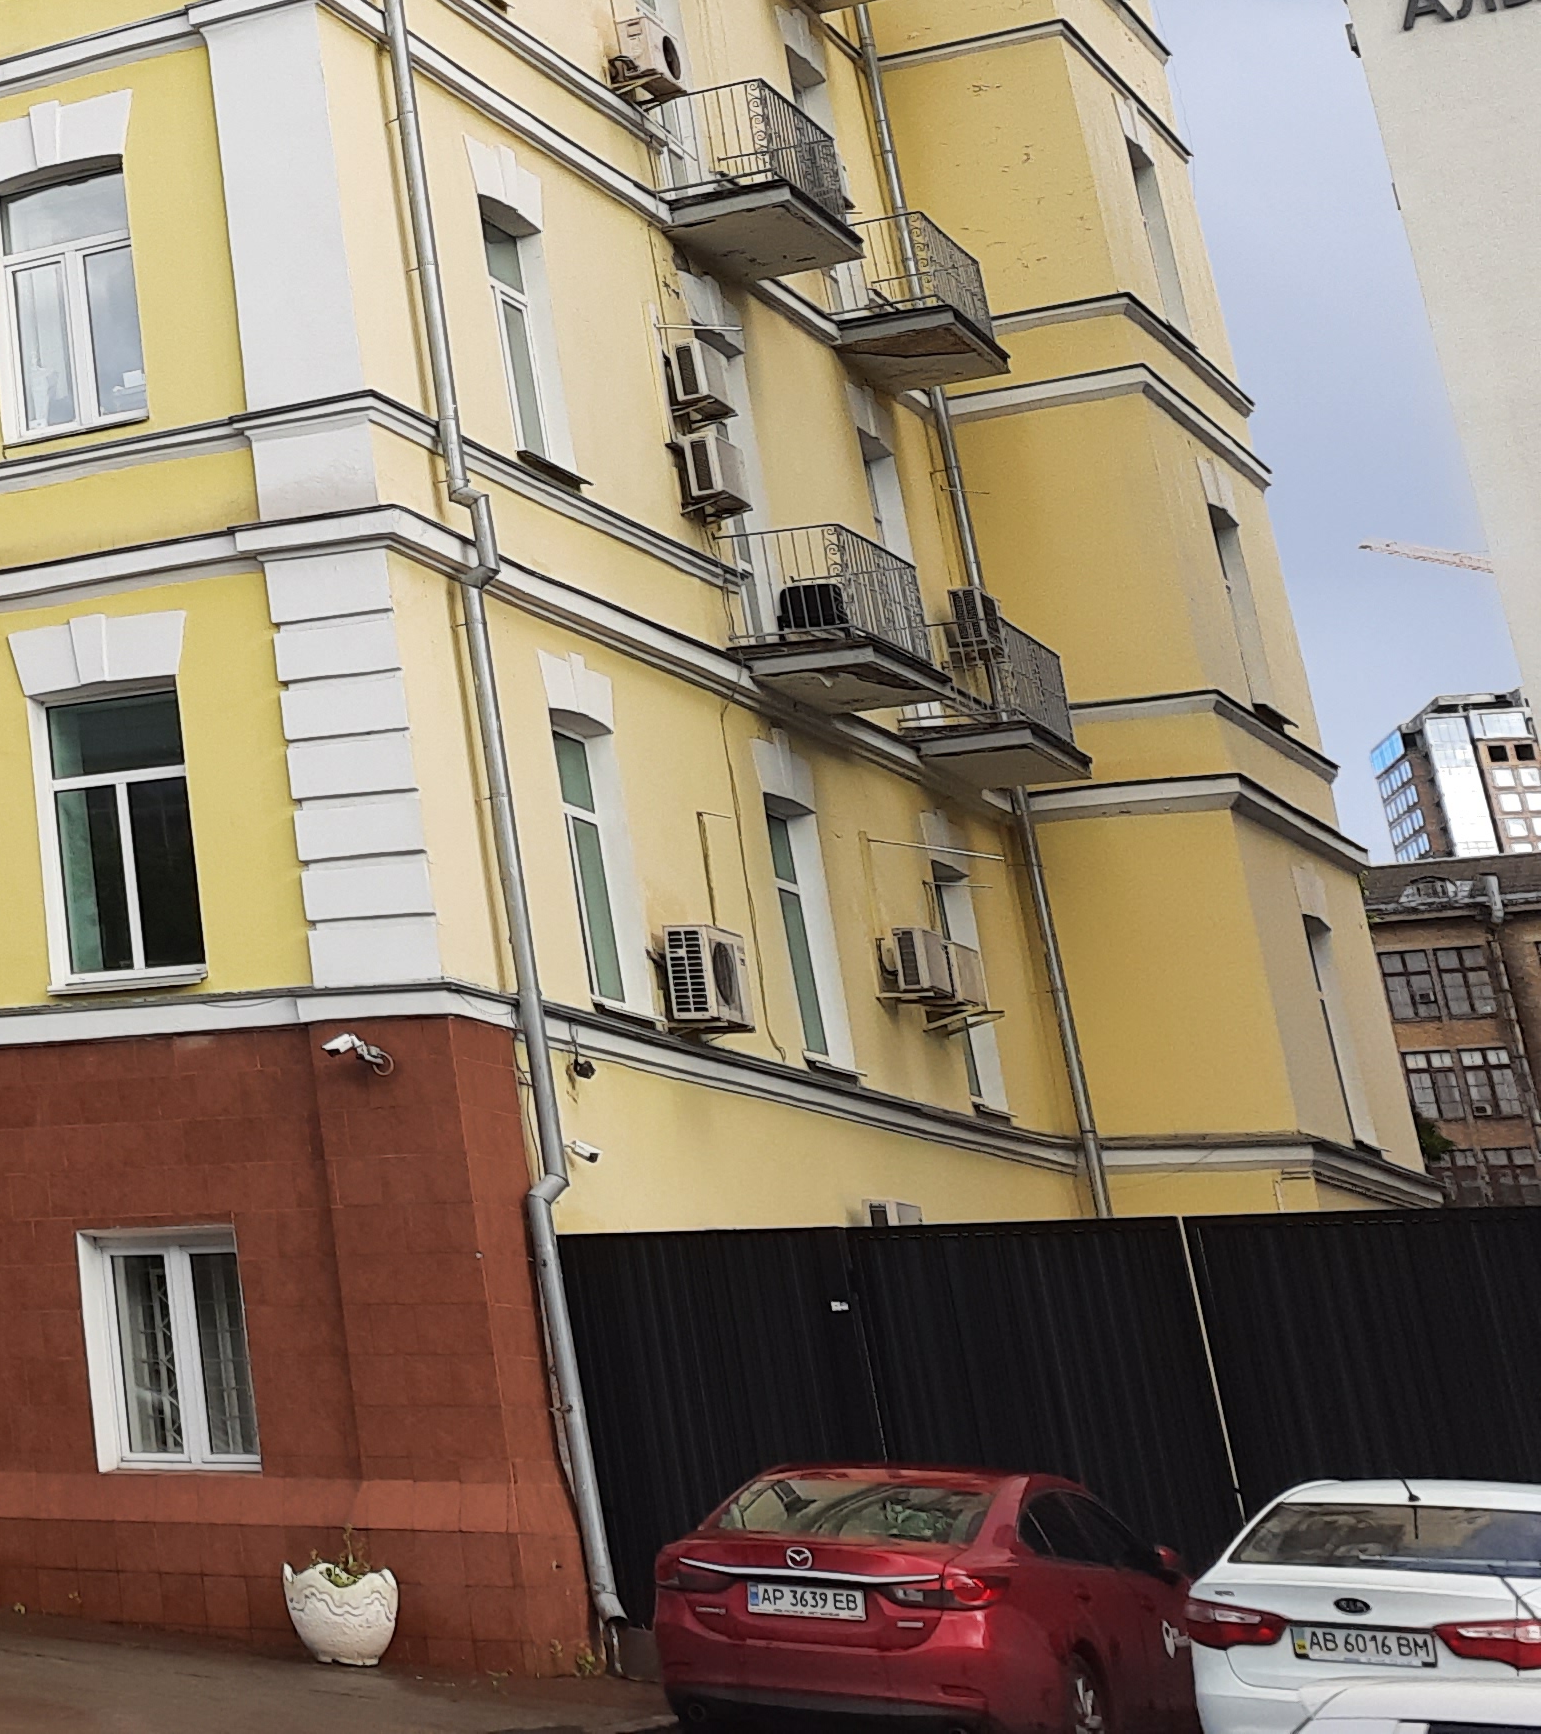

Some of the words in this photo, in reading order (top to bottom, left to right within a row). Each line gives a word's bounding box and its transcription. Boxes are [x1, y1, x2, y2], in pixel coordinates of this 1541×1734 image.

[761, 1588, 784, 1605] AP
[789, 1589, 828, 1609] 3639
[833, 1592, 858, 1611] EB
[1310, 1631, 1338, 1652] AB
[1344, 1633, 1392, 1655] 6016
[1397, 1635, 1430, 1657] BM
